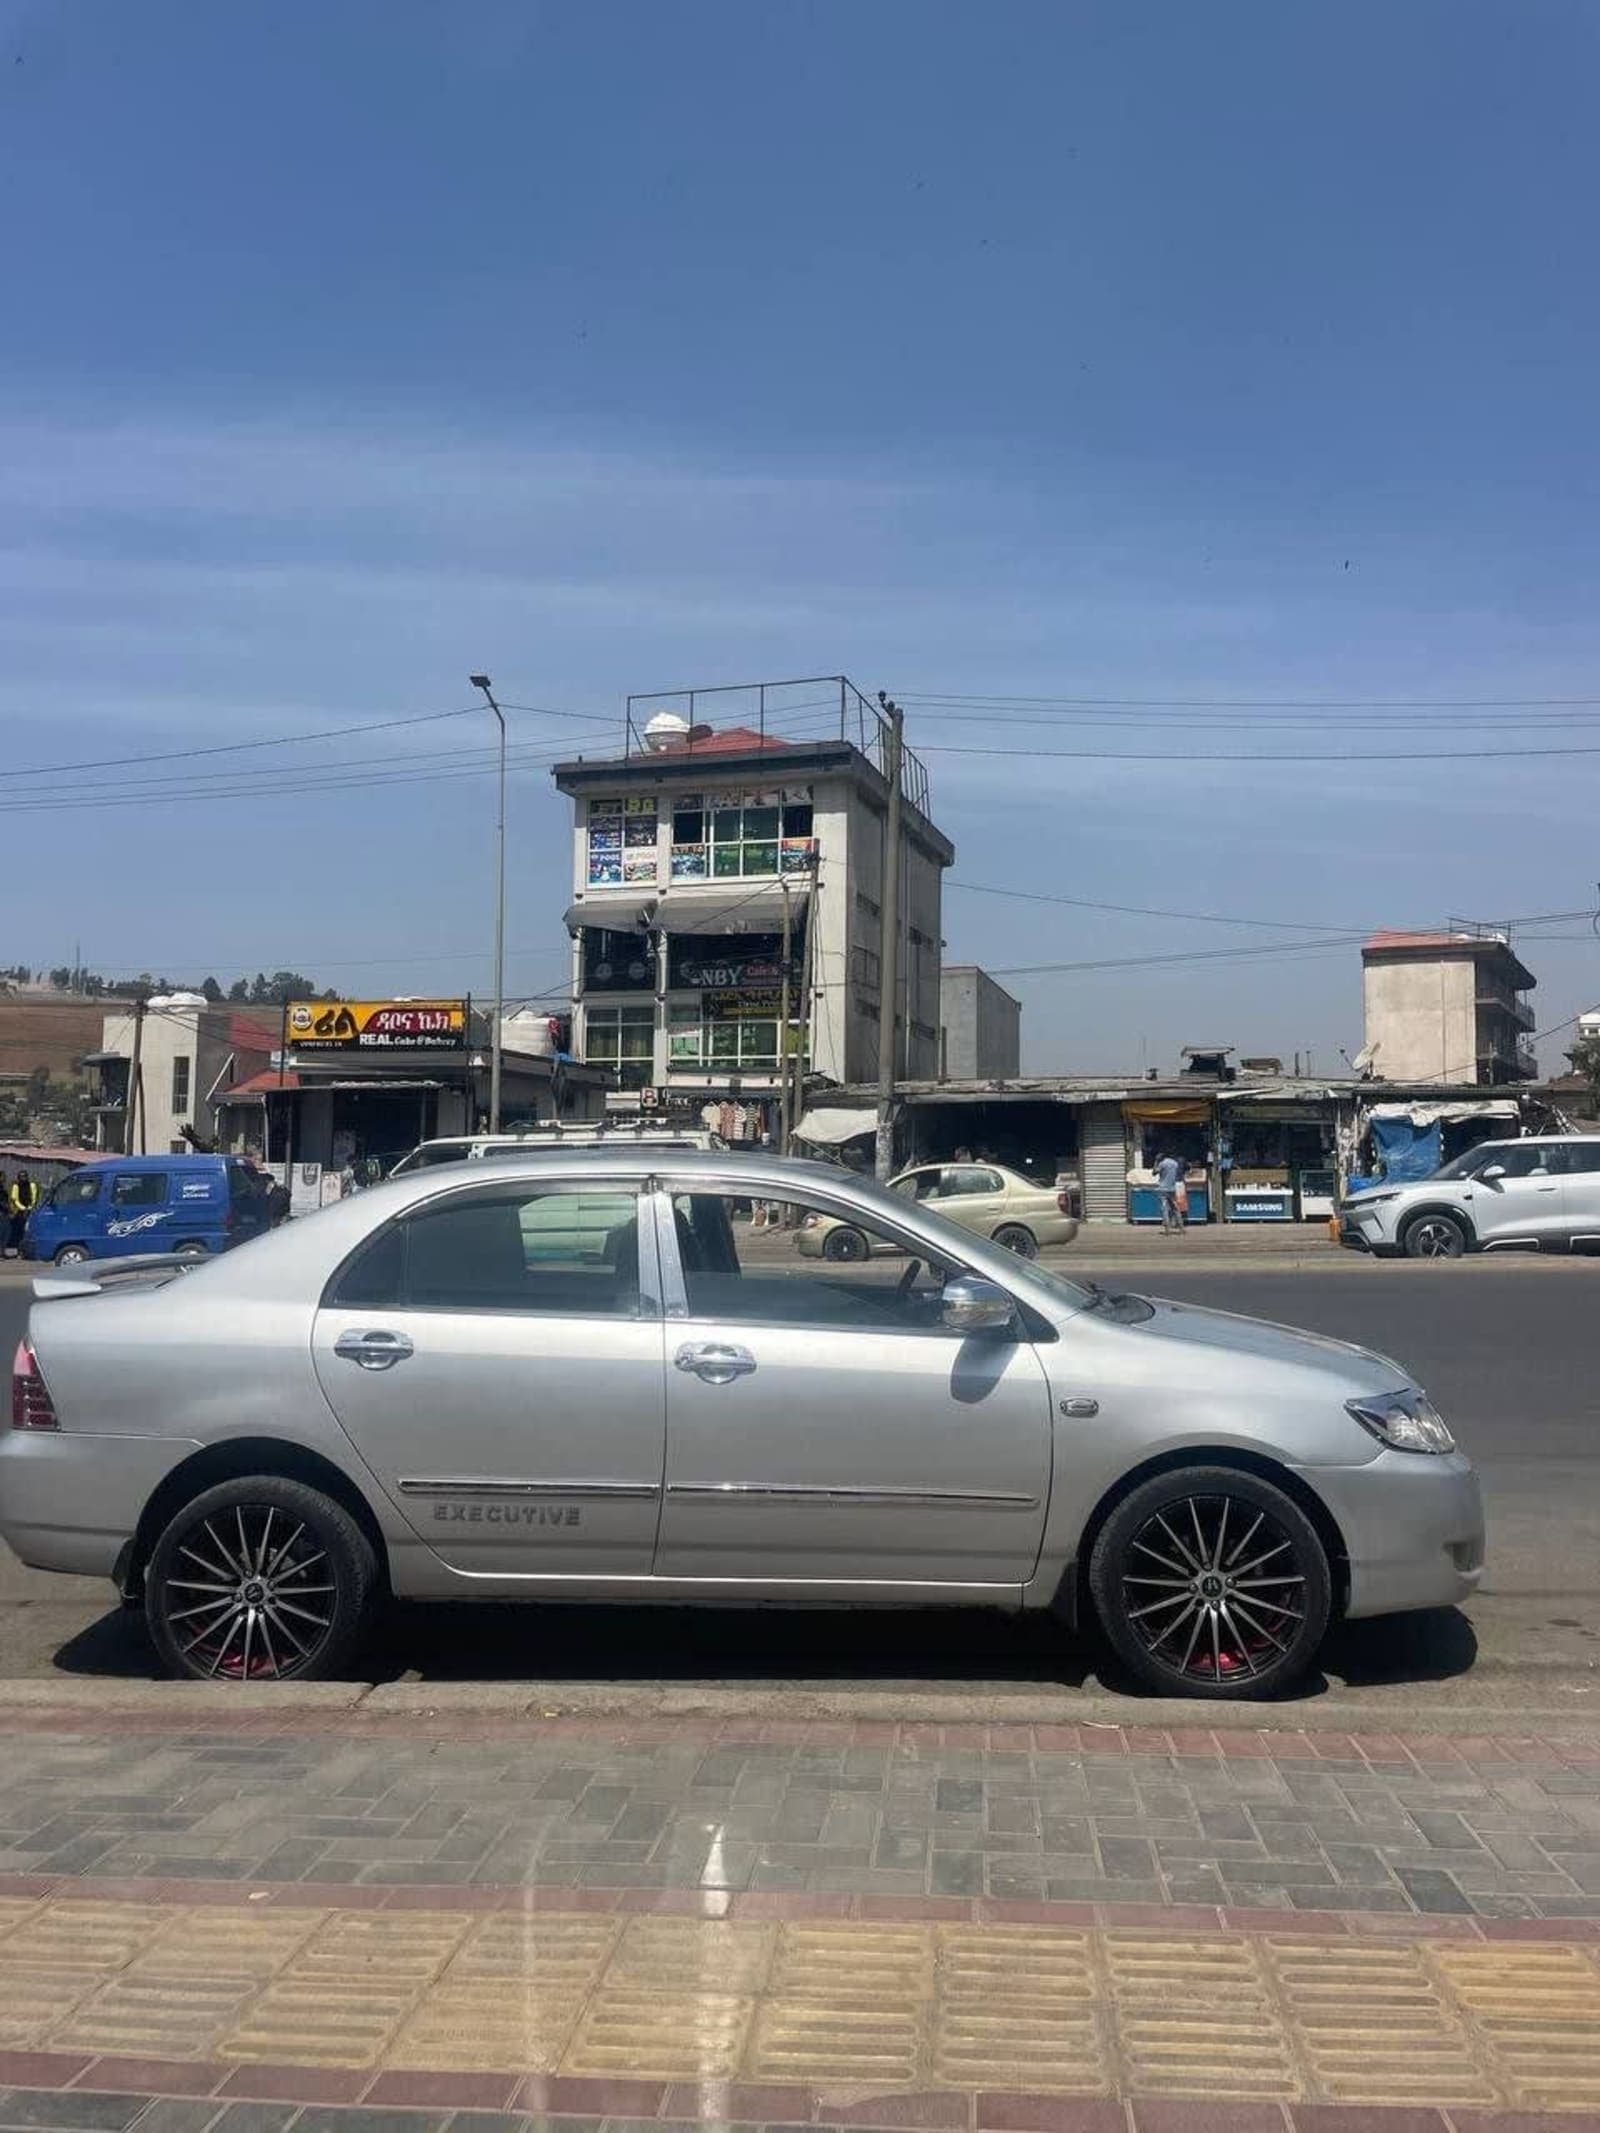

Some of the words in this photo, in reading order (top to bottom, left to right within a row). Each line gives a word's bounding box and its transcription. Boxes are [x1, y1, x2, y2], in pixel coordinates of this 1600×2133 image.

[359, 1033, 394, 1046] REAL
[1235, 1202, 1283, 1211] SAMSUNG
[434, 1504, 580, 1526] EXECUTIVE
